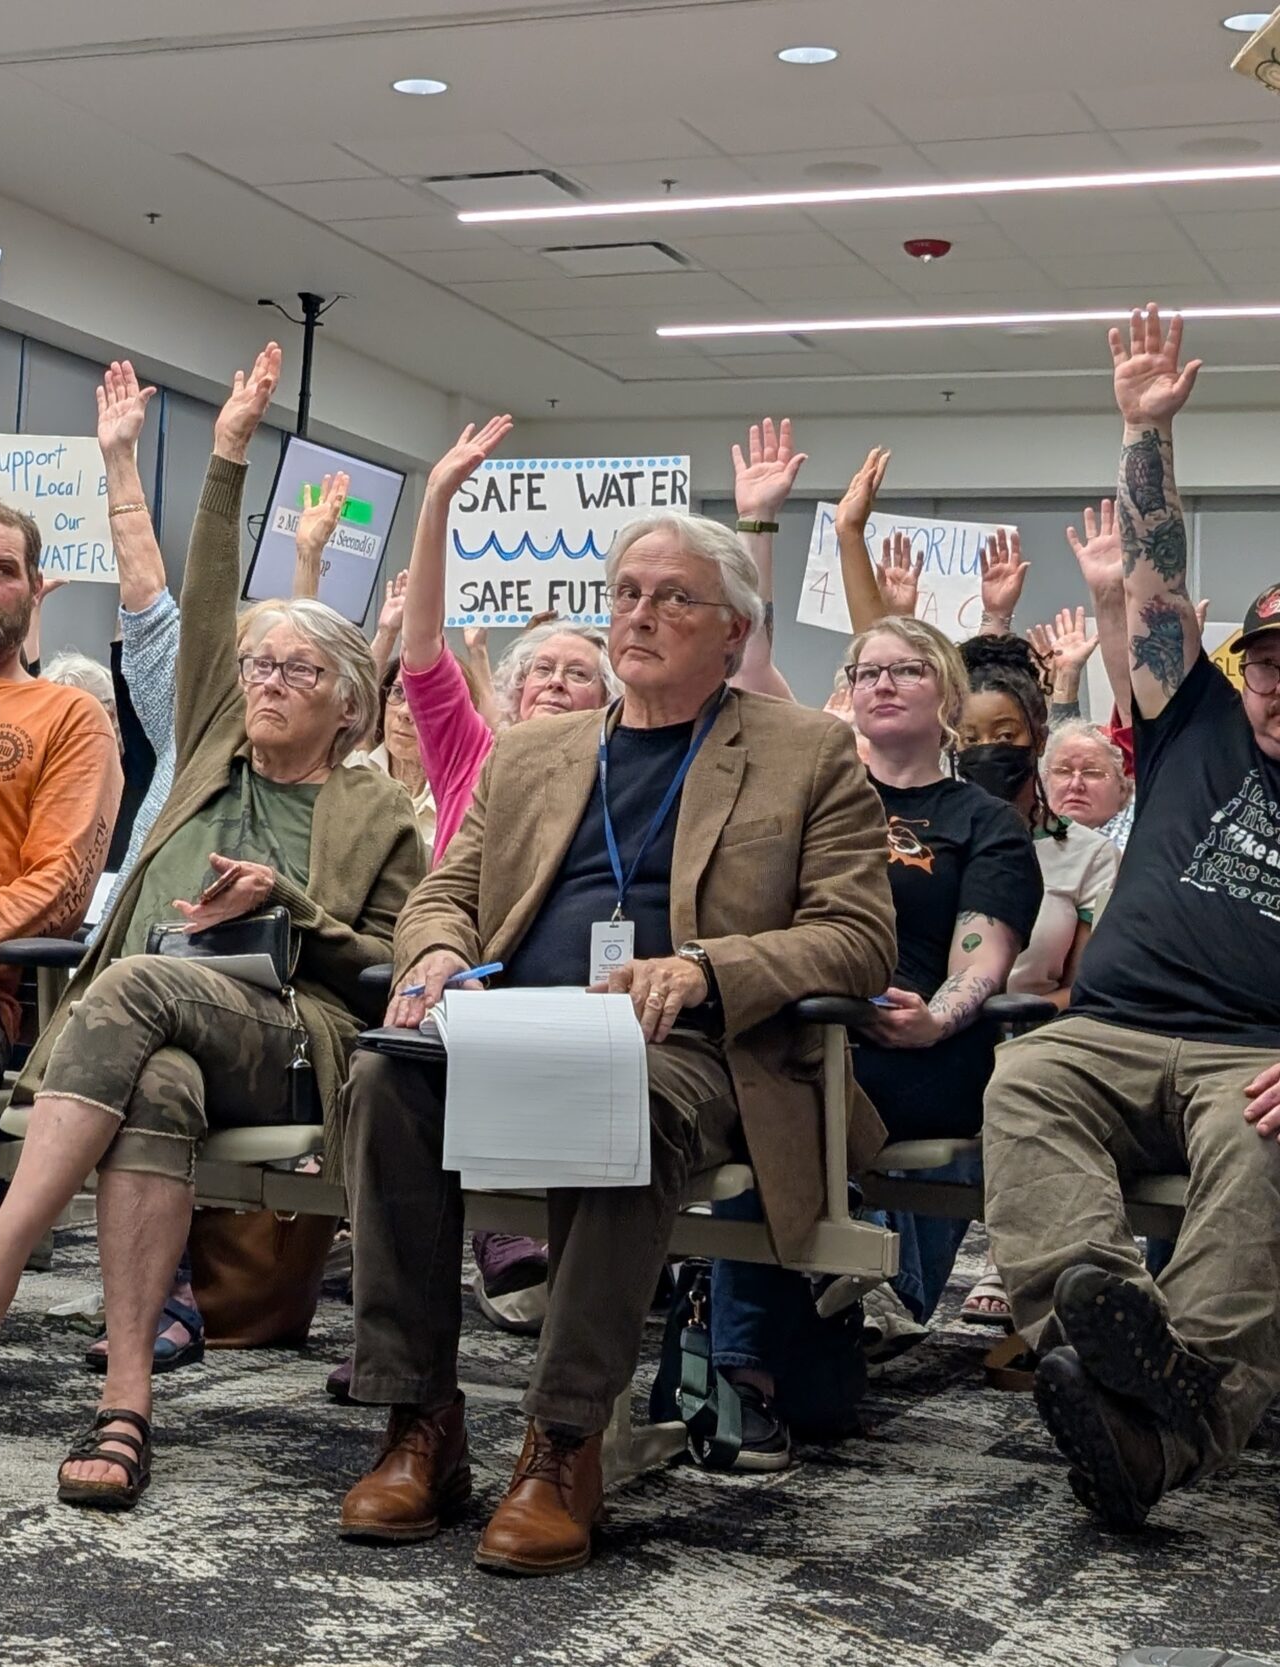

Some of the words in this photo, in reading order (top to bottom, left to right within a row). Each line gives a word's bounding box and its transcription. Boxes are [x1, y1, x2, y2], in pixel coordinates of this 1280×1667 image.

[35, 470, 82, 497] Local
[458, 472, 547, 513] SAFE
[576, 469, 688, 509] WATER
[54, 512, 85, 531] Our
[277, 516, 285, 529] 2
[337, 529, 376, 557] Second(s)
[459, 579, 533, 613] SAFE
[548, 580, 607, 615] FUT
[809, 571, 836, 614] 4
